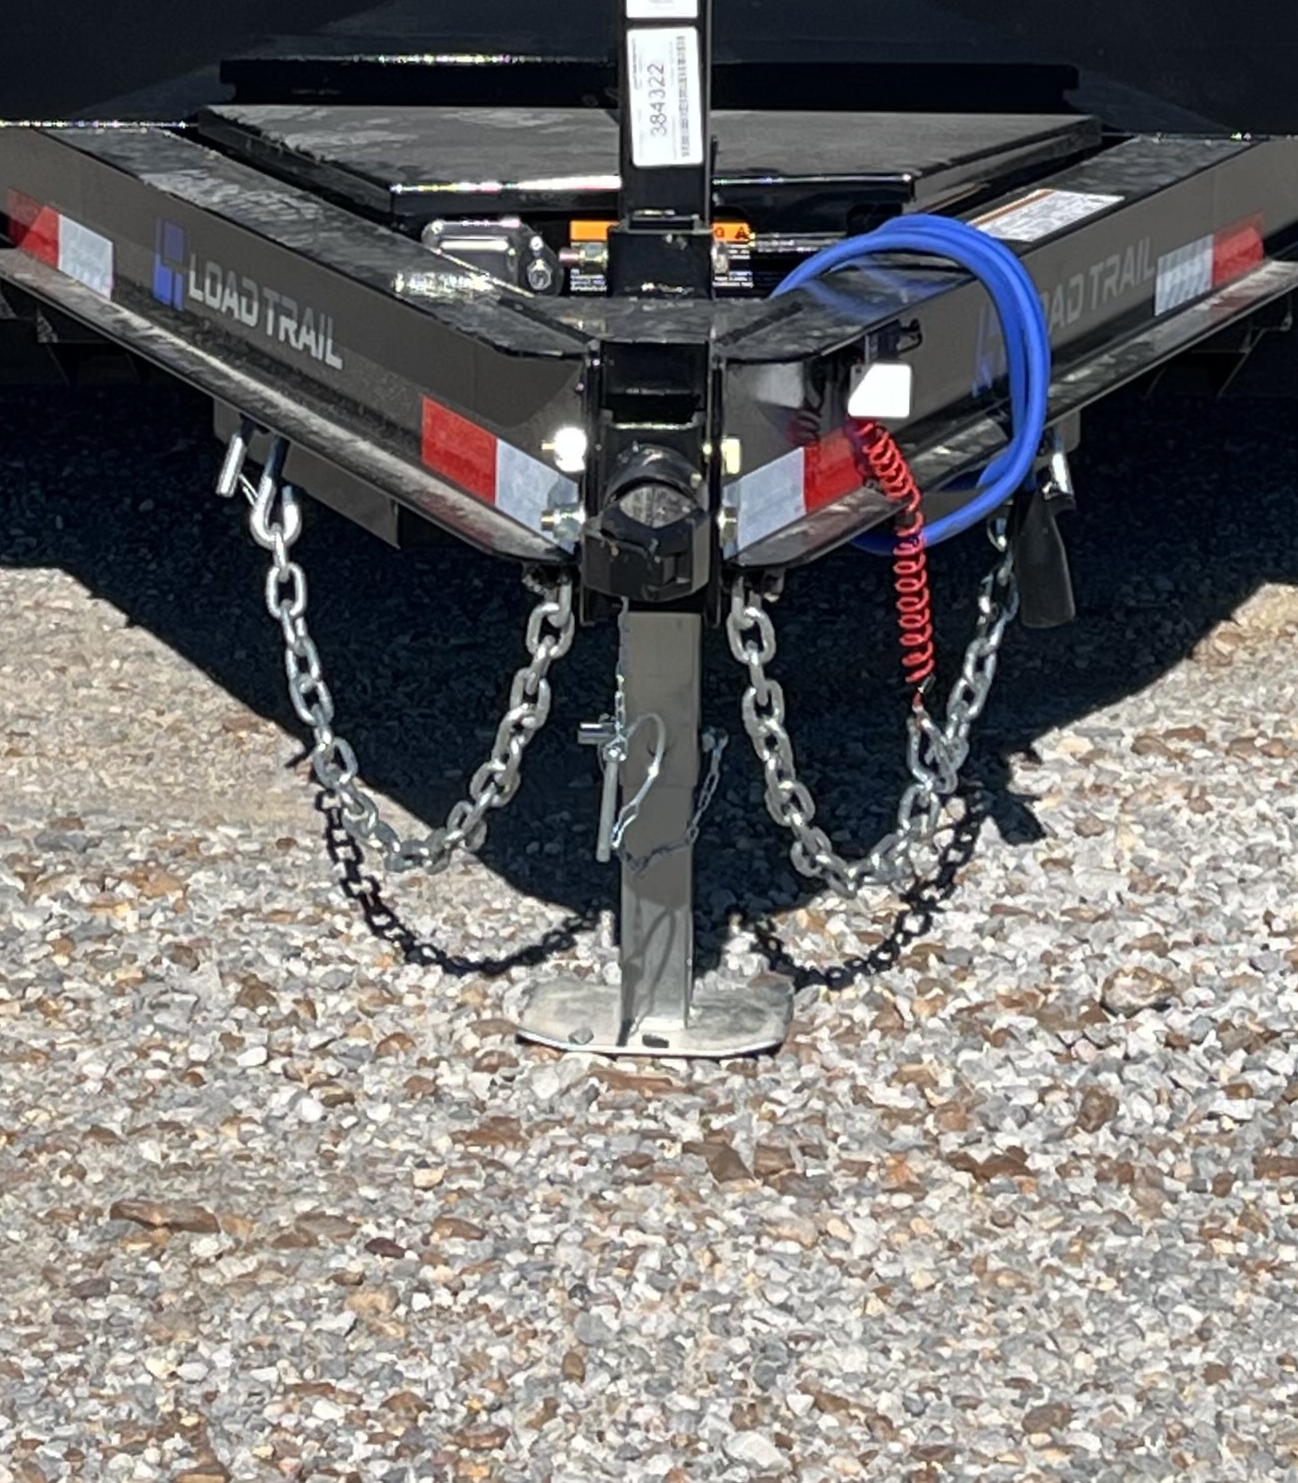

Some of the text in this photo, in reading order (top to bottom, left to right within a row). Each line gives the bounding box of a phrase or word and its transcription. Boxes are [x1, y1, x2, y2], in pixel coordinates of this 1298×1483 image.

[646, 63, 668, 137] 384322
[189, 252, 344, 370] LOAD TRAIL
[1088, 236, 1153, 311] TRAIL
